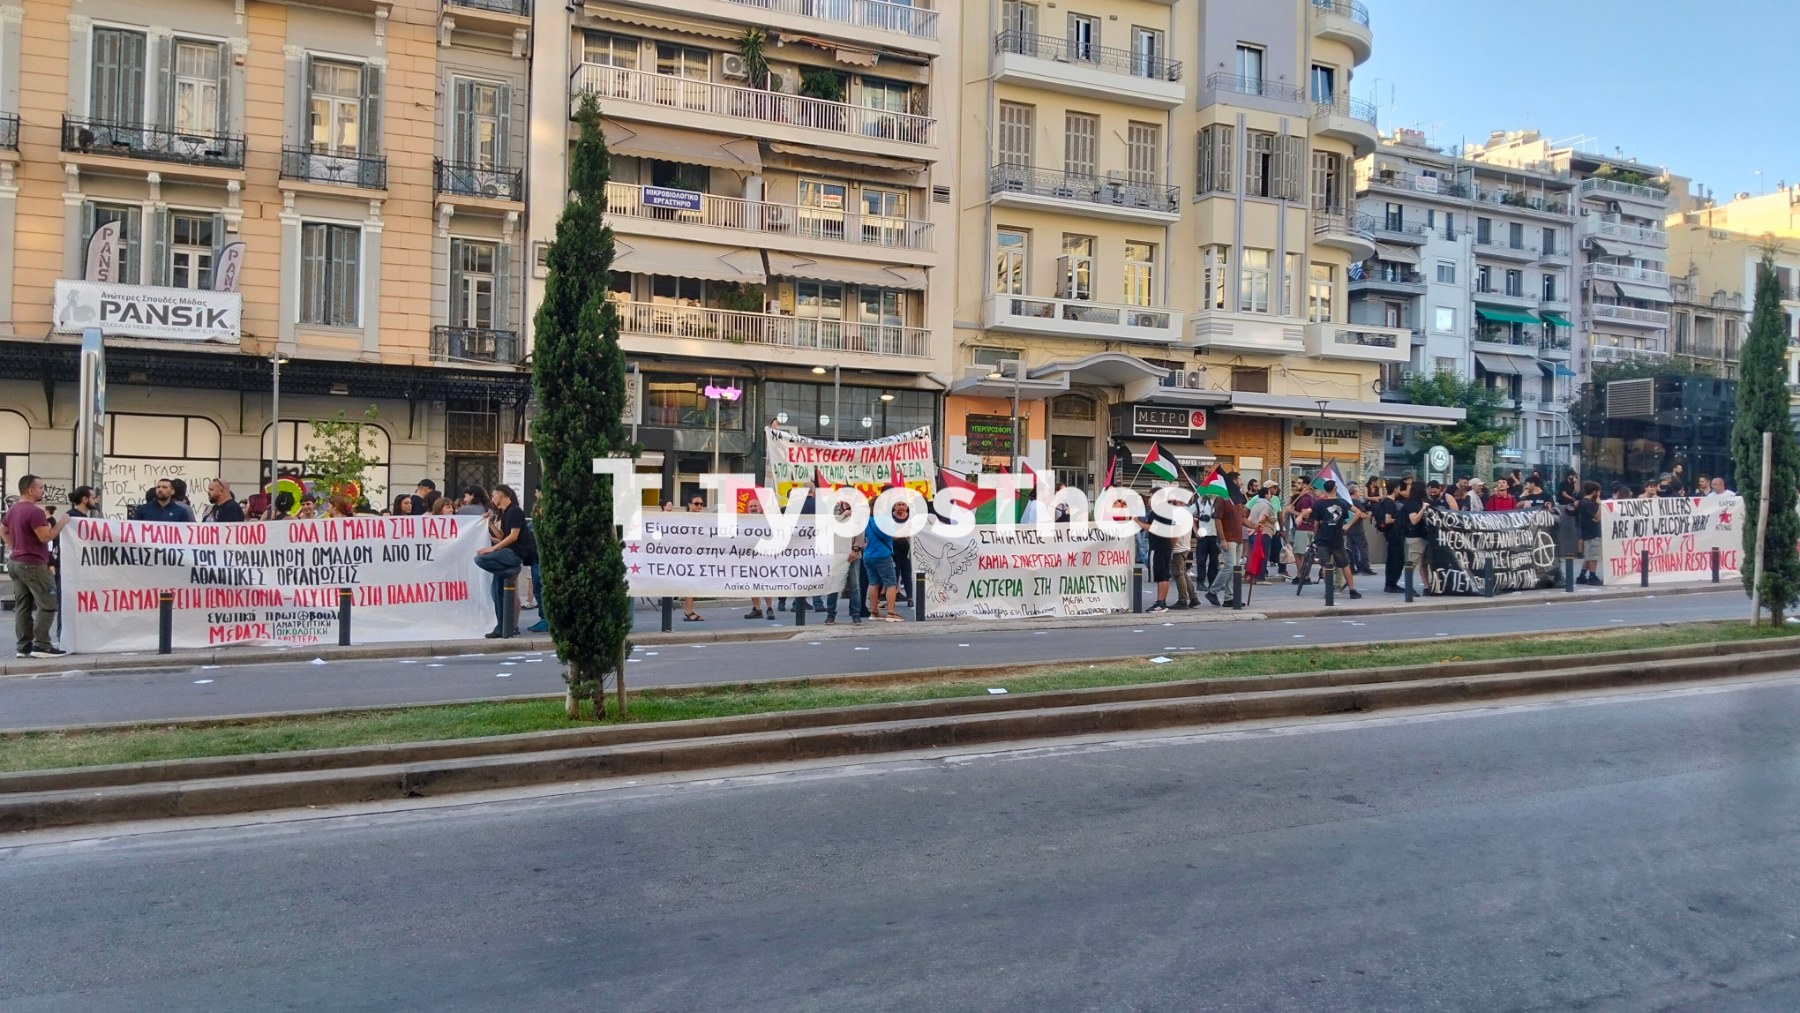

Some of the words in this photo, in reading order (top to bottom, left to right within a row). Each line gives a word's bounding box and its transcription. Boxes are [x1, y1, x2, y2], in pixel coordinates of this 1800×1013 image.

[646, 189, 699, 201] ΜΙΚΡΟΒΙΟΛΟΓΙΚΟ
[653, 197, 691, 207] ΕΡΓΑΣΤΗΡΙΟ
[101, 292, 141, 302] Ανώτερες
[142, 295, 177, 305] Σπουδές
[179, 298, 207, 307] Μόδας
[1139, 411, 1185, 423] ΜΕΤΡΟ
[1193, 415, 1203, 425] 43
[971, 425, 1013, 433] ΥΠΕΡΠΡΟΣΦΟΡΕ
[1315, 428, 1358, 439] ΓΑΤΙΔΗΣ
[788, 446, 855, 462] ΕΛΕΥΘΕΡΗ
[860, 441, 928, 463] ΠΑΛΑΙΣΤΙΝΗ
[144, 464, 186, 476] ΠΥΛΟΣ
[774, 463, 787, 477] ΑΠΟ
[862, 465, 871, 478] ΤΗ
[1618, 499, 1653, 517] ZIONIST
[1658, 498, 1691, 516] KILLERS
[78, 519, 112, 543] ΟΛΑ
[120, 521, 136, 543] ΤΑ
[141, 522, 182, 544] ΜΑΤΙΑ
[186, 524, 219, 544] ΣΤΟΝ
[225, 523, 266, 544] ΣΤΟΛΟ
[289, 521, 319, 543] ΟΛΑ
[323, 519, 338, 542] ΤΑ
[343, 517, 385, 540] ΜΑΤΙΑ
[389, 518, 414, 540] ΣΤΗ
[422, 516, 458, 539] ΓΑΖΑ
[645, 522, 704, 537] Είμαστε
[710, 525, 739, 539] μαζί
[744, 528, 772, 537] σου
[1612, 520, 1628, 539] ARE
[1633, 518, 1649, 537] NOT
[1652, 515, 1689, 535] WELCOME
[646, 543, 693, 555] Θάνατο
[697, 547, 725, 558] στην
[1622, 537, 1672, 556] VICTORY
[1679, 534, 1694, 553] TO
[81, 547, 185, 567] ΑΠΟΚΛΕΙΣΜΟΣ
[312, 545, 372, 565] ΟΜΑΔΩΝ
[383, 544, 409, 562] ΑΠΟ
[416, 543, 434, 562] ΤΙΣ
[978, 554, 1008, 570] ΚΑΜΙΑ
[1012, 552, 1062, 568] ΣΥΝΕΡΓΑΣΙΑ
[1067, 551, 1077, 567] ΜΕ
[1082, 551, 1091, 566] ΤΟ
[1098, 550, 1132, 566] ΙΣΡΑΗΛ
[648, 563, 695, 577] ΤΕΛΟΣ
[699, 564, 726, 577] ΣΤΗ
[731, 564, 823, 578] ΓΕΝΟΚΤΟΝΙΑ
[1610, 558, 1627, 576] THE
[1685, 550, 1737, 571] RESISTNCE
[191, 567, 266, 585] ΑΘΛΗΤΙΚΕΣ
[277, 565, 360, 585] ΟΡΓΑΝΩΣΕΙΣ
[724, 582, 751, 591] Λαϊκό
[967, 578, 1023, 599] ΛΕΥΤΕΡΙΑ
[1034, 577, 1051, 596] ΣΤΗ
[1060, 575, 1126, 596] ΠΑΛΑΙΣΤΙΝΗ
[77, 591, 99, 612] ΝΑ
[104, 588, 189, 612] ΣΤΑΜΑΤΣΕΙ
[193, 589, 201, 609] Η
[359, 585, 382, 607] ΣΤΗ
[388, 581, 468, 605] ΠΑΛΑΙΣΤΙΝΗ
[276, 620, 331, 628] ΑΝΑΤΡΕΠΤΙΚΗ
[277, 628, 328, 636] ΟΙΚΟΛΟΓΙΚΗ
